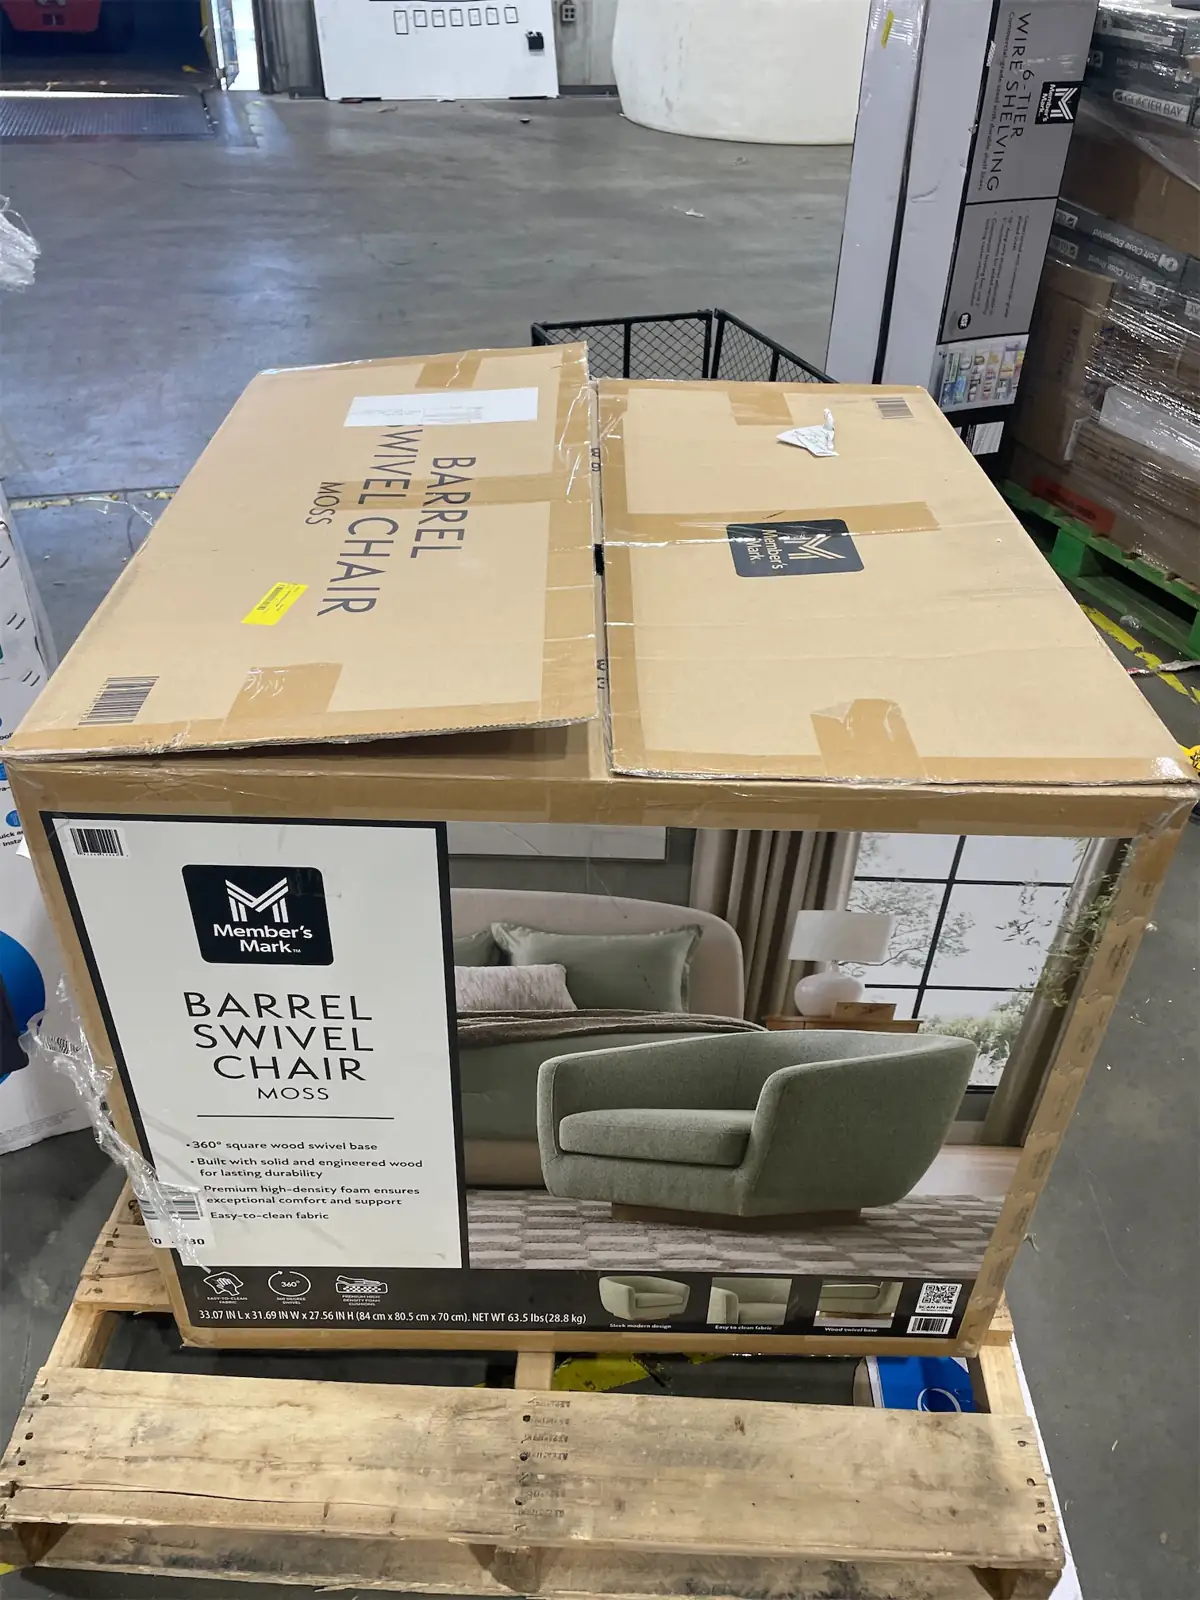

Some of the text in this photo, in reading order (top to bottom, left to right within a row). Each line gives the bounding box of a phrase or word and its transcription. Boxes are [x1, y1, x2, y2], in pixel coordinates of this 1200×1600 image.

[1008, 12, 1032, 72] WIRE
[1011, 69, 1035, 139] 6-TIER
[1042, 84, 1057, 122] Member's
[1124, 93, 1184, 117] GLACIER BAY
[986, 81, 1019, 191] SHELVING
[1125, 241, 1143, 256] Close
[1144, 250, 1159, 262] Soft
[1107, 263, 1124, 277] Close
[357, 424, 423, 505] WIVEL
[305, 481, 346, 525] MOSS
[410, 457, 477, 558] BARREL
[761, 529, 784, 570] Member's
[316, 517, 399, 617] CHAIR
[0, 831, 15, 839] uick
[213, 923, 313, 939] Member's
[183, 991, 373, 1020] BARREL
[194, 1024, 374, 1052] SWIVEL
[213, 1055, 366, 1081] CHAIR
[258, 1086, 329, 1100] MOSS
[192, 1141, 378, 1151] 360° square wood swivel base
[197, 1157, 423, 1169] Built with solid and engineered wood
[200, 1169, 323, 1180] for lasting durability
[204, 1185, 420, 1195] Premium high-density foam ensures
[207, 1196, 403, 1207] exceptional comfort and support
[211, 1211, 329, 1221] Easy-to-clean fabric
[199, 1310, 223, 1320] 33.07
[226, 1311, 237, 1320] IN
[238, 1311, 244, 1320] L
[252, 1310, 277, 1320] 31.69
[279, 1311, 289, 1320] IN
[290, 1311, 300, 1320] W
[308, 1311, 334, 1321] 27.56
[335, 1311, 346, 1321] IN
[347, 1311, 354, 1321] H
[356, 1311, 371, 1322] (84
[394, 1312, 414, 1321] 80.5
[438, 1312, 449, 1321] 70
[451, 1312, 471, 1323] cm).
[472, 1312, 488, 1322] NET
[490, 1312, 506, 1322] WT
[507, 1313, 529, 1322] 63.5
[530, 1313, 544, 1323] lbs
[544, 1313, 570, 1324] (28.8
[571, 1313, 587, 1324] kg)
